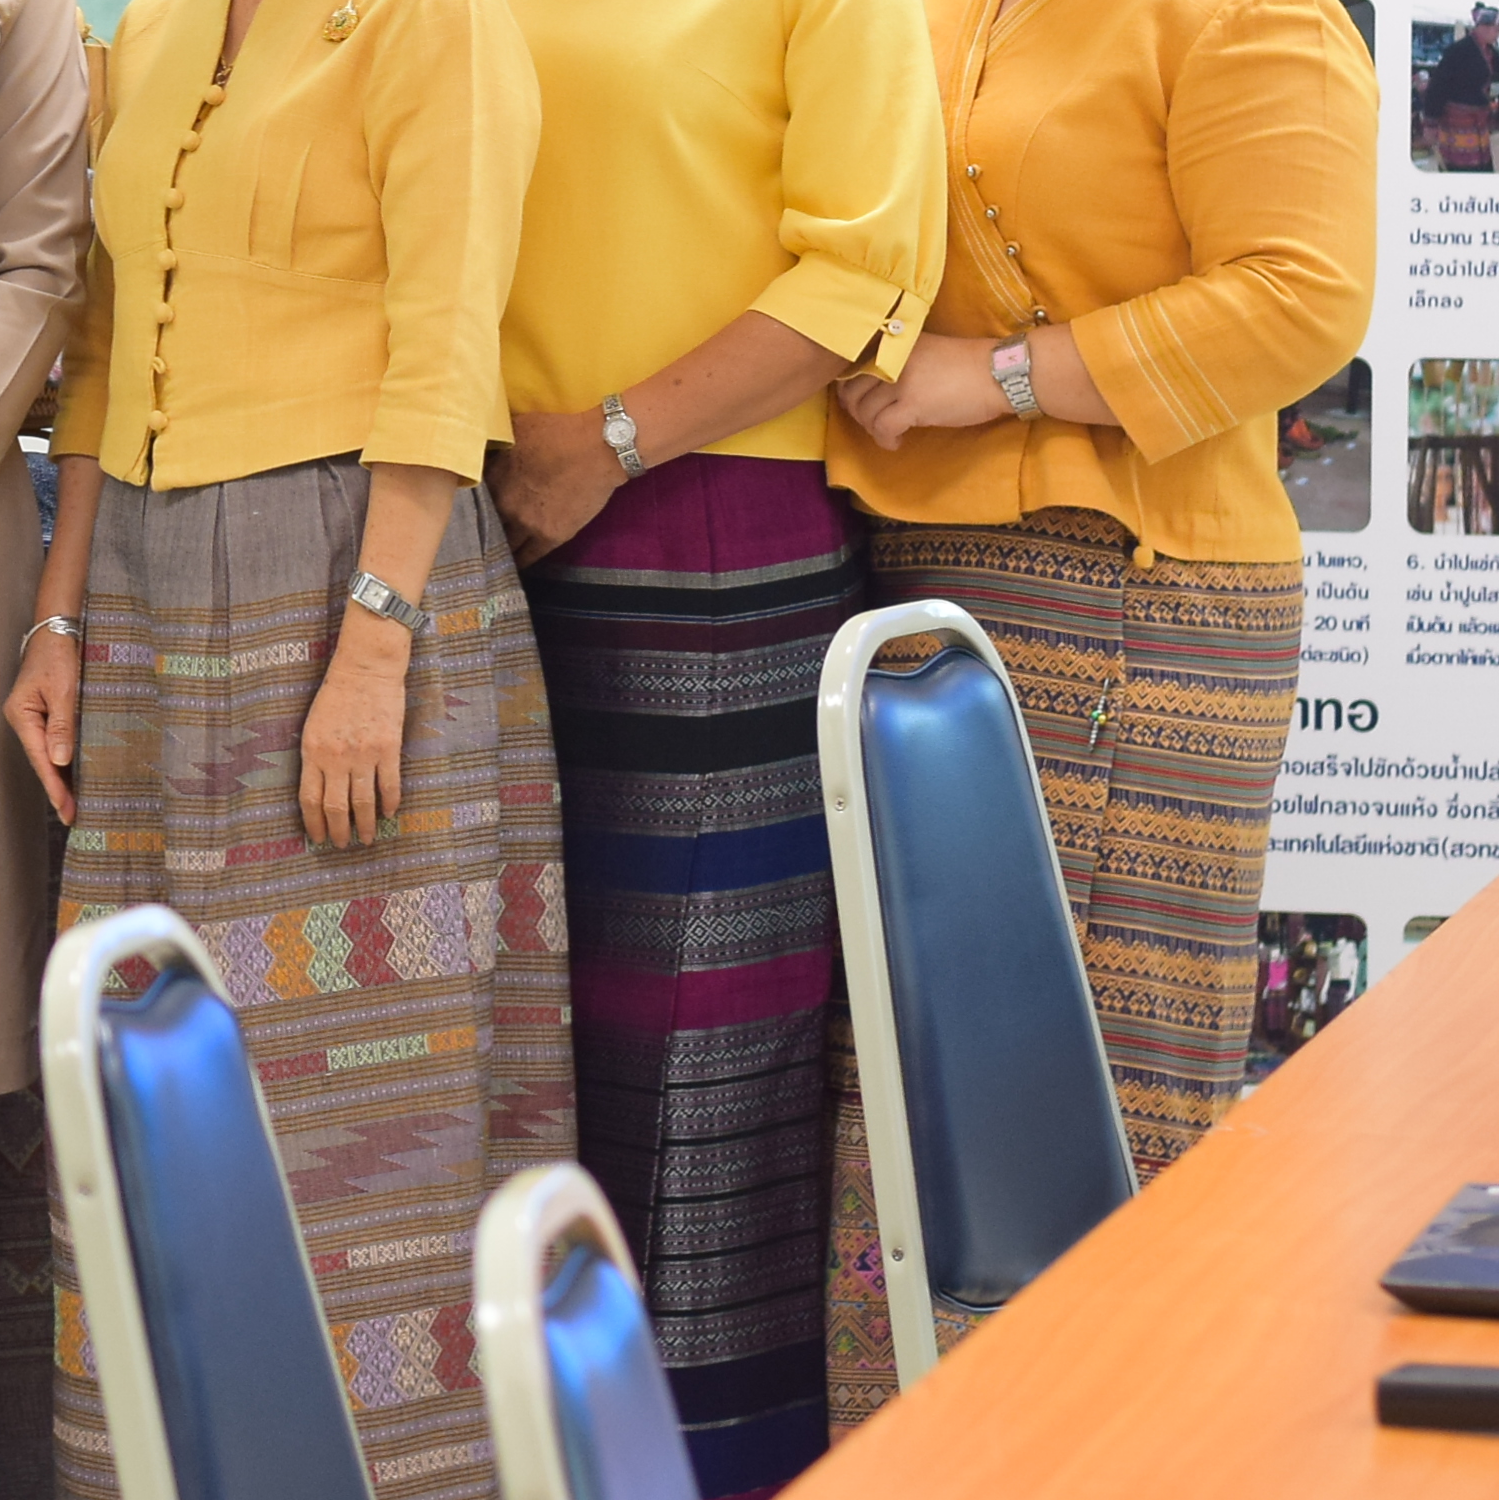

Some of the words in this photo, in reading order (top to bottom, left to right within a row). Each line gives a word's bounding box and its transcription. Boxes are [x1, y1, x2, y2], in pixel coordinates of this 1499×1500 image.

[1409, 227, 1473, 245] ประมาณ
[1408, 288, 1464, 309] เล็กลง
[1316, 580, 1370, 600] เป็นต้น
[1406, 584, 1433, 601] เช่น
[1314, 615, 1338, 632] 20
[1343, 613, 1371, 632] นาที
[1406, 614, 1453, 634] เป็นต้น
